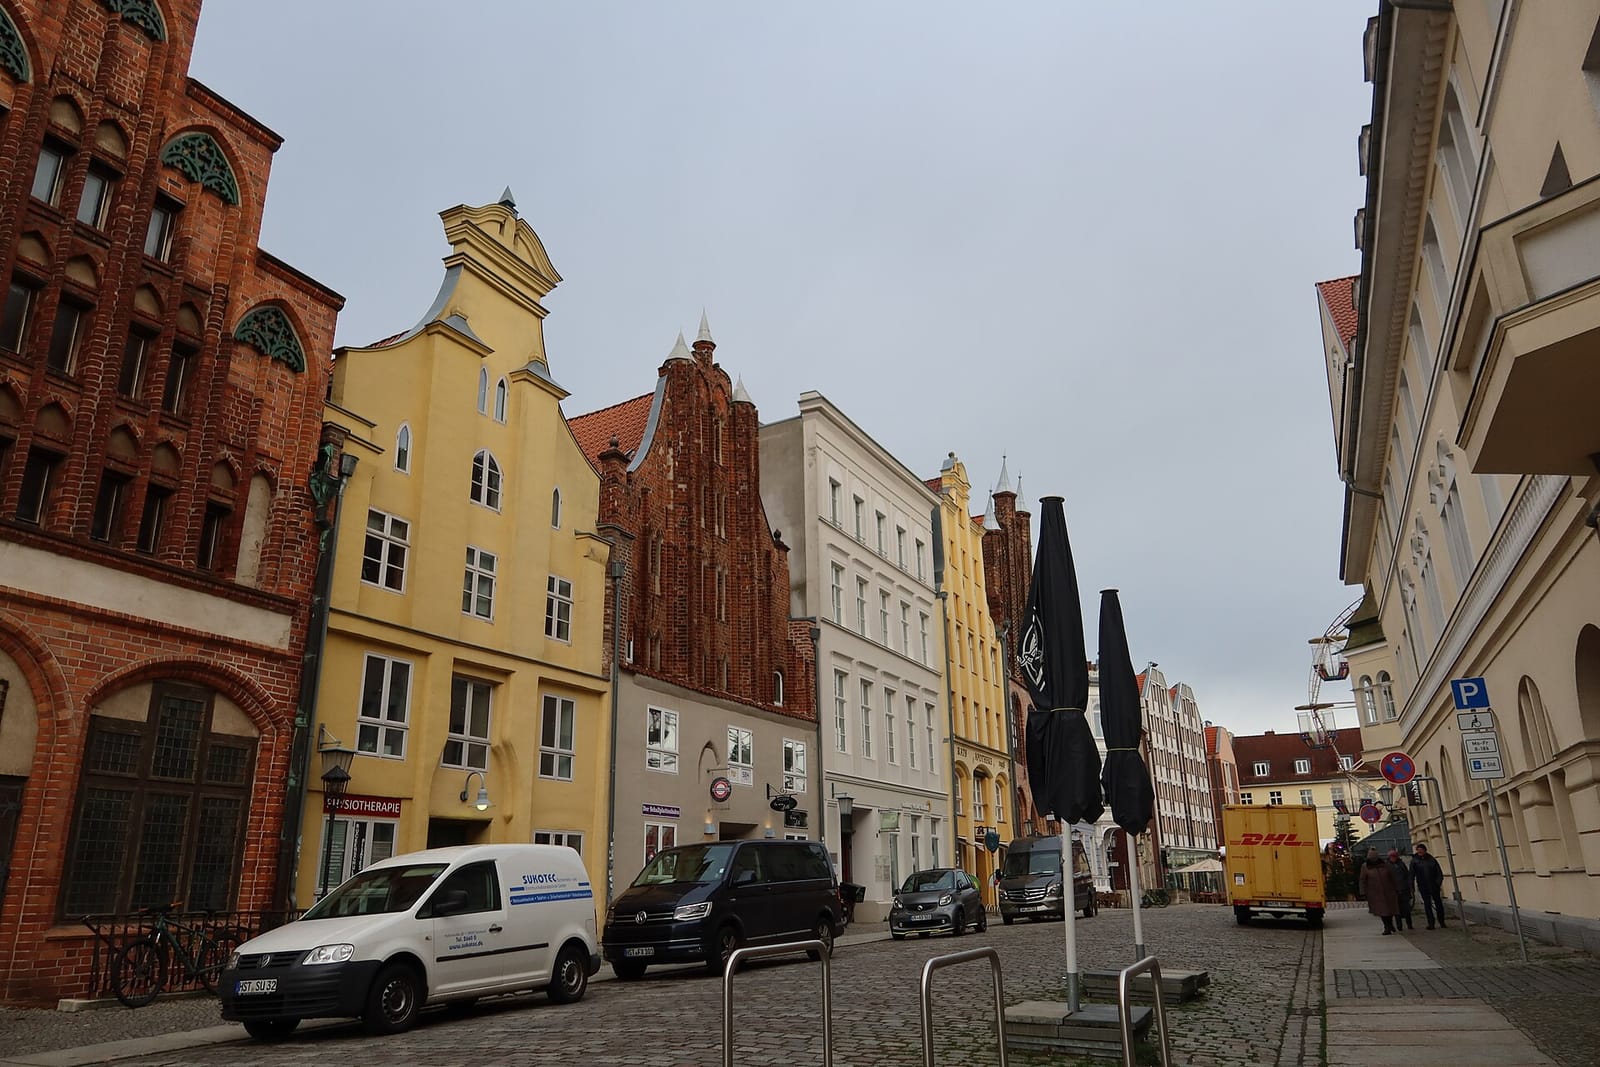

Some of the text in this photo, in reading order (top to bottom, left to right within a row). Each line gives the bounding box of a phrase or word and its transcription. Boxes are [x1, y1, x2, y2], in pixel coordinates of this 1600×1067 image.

[1459, 682, 1479, 706] P
[326, 798, 401, 814] PHYSIOTHERAPIE
[1241, 833, 1303, 847] DHL
[522, 873, 557, 885] SUKOTEC
